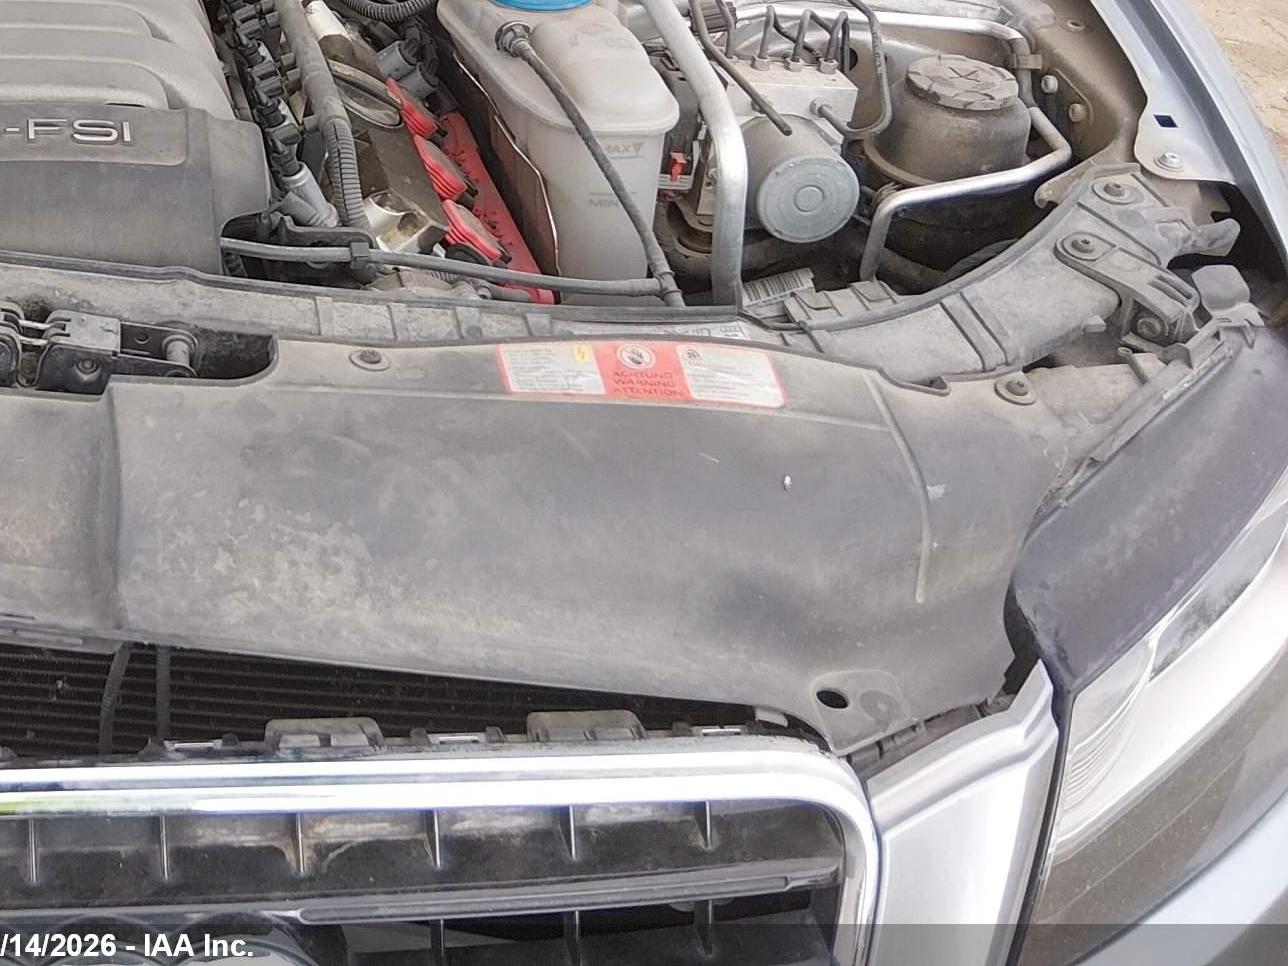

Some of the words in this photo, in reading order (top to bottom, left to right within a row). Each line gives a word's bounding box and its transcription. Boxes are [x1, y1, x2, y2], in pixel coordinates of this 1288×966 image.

[613, 370, 673, 379] ACHTUNG
[613, 378, 676, 387] WARNING
[613, 387, 683, 396] ATTENTION
